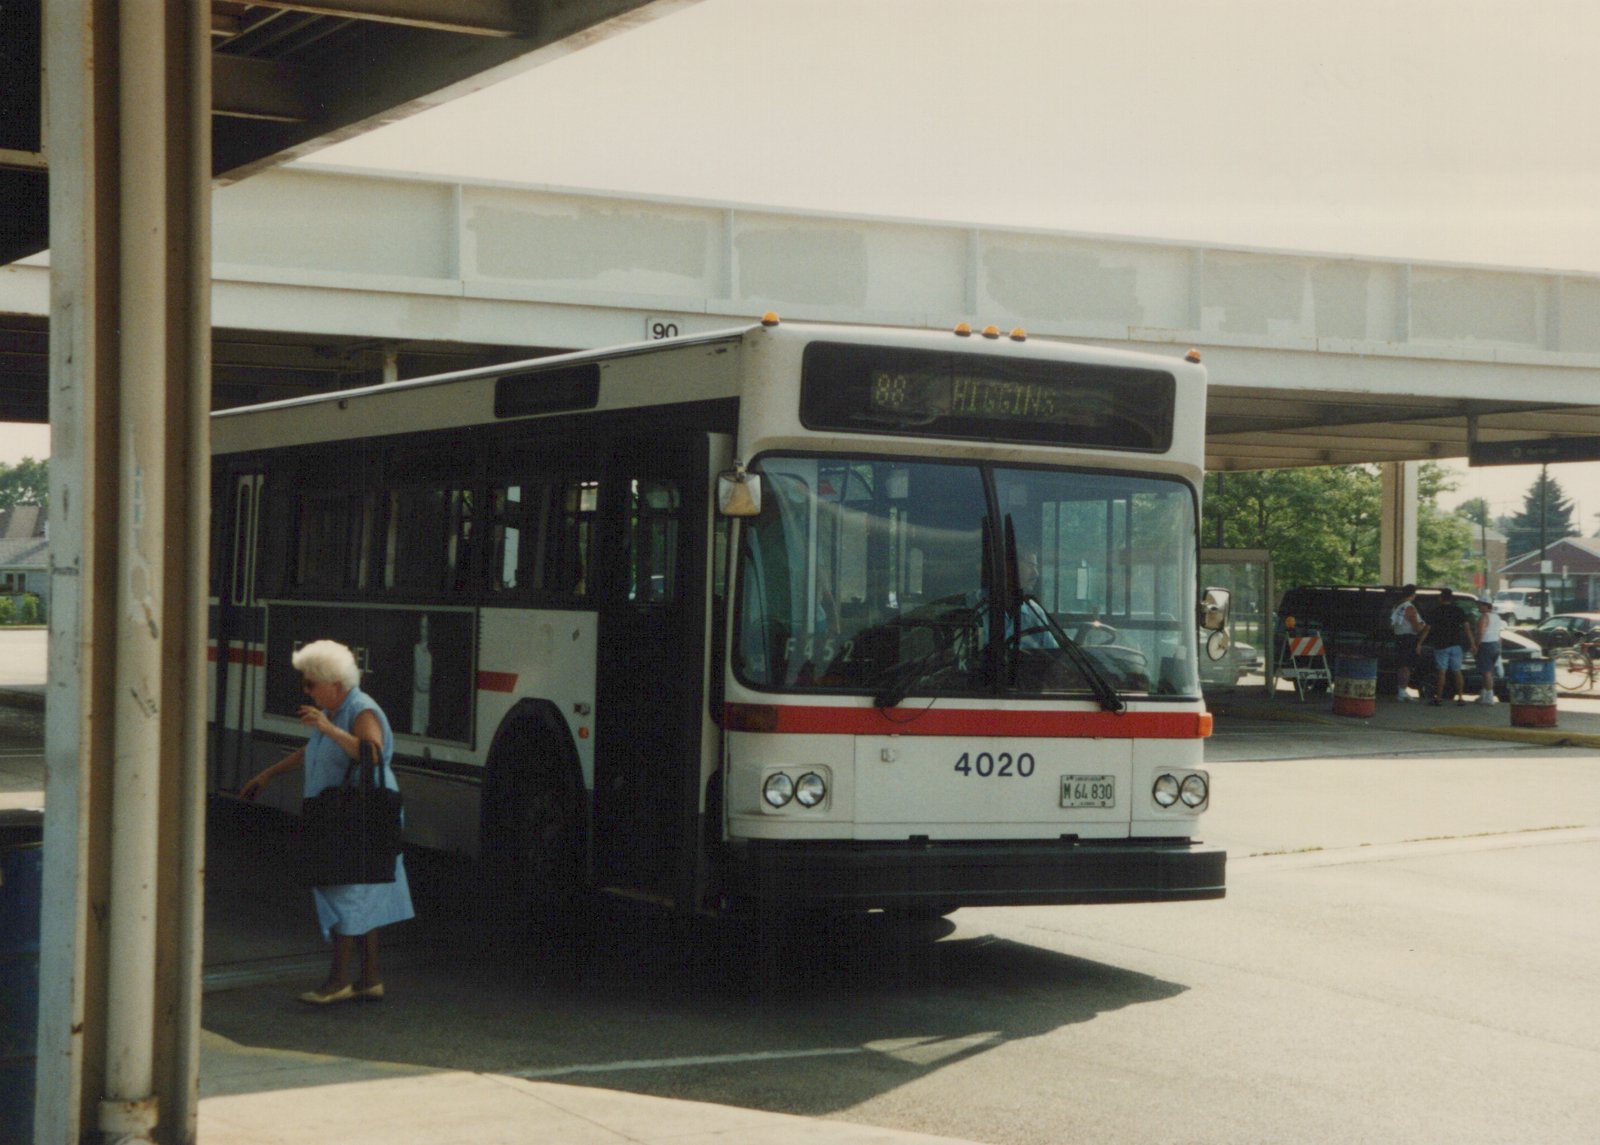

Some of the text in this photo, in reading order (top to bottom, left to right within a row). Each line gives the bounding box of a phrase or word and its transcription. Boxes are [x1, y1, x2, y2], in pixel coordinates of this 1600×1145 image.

[652, 322, 679, 339] 90
[875, 372, 1056, 418] 88 HIGGINS
[954, 752, 1035, 777] 4020
